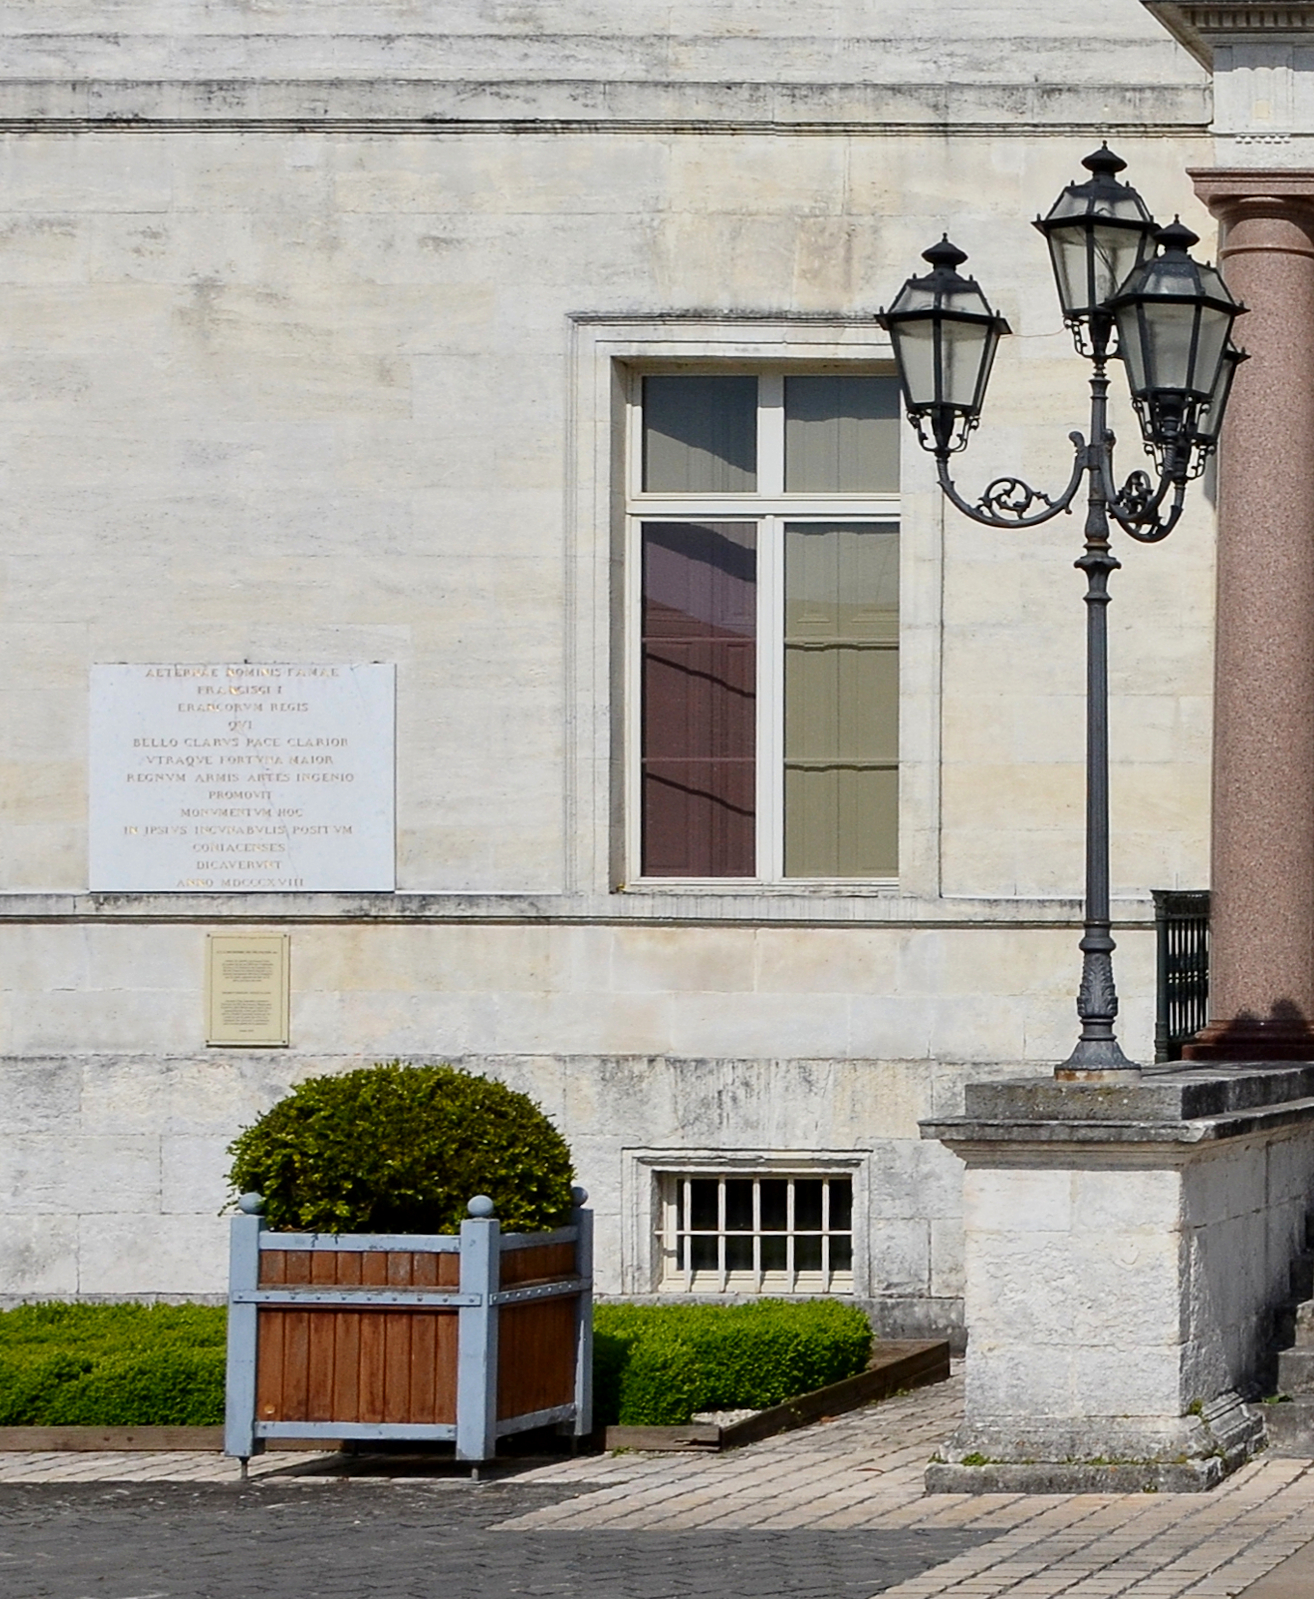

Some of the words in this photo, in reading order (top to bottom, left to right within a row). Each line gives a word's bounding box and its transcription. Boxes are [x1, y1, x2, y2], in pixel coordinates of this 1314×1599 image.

[145, 668, 218, 677] AETERNAE
[270, 703, 309, 712] REGIS
[133, 738, 178, 747] BELLO
[184, 738, 239, 747] CLARVS
[246, 738, 281, 747] PACE
[287, 738, 348, 747] CLARIOR
[289, 756, 334, 764] MAIOR
[127, 773, 186, 782] REGNVM
[195, 773, 239, 782] ARMIS
[296, 773, 354, 782] INGENIO
[208, 790, 272, 800] PROMOVIT
[277, 808, 303, 817] HOC
[124, 826, 138, 835] IN
[176, 878, 213, 887] ANNO
